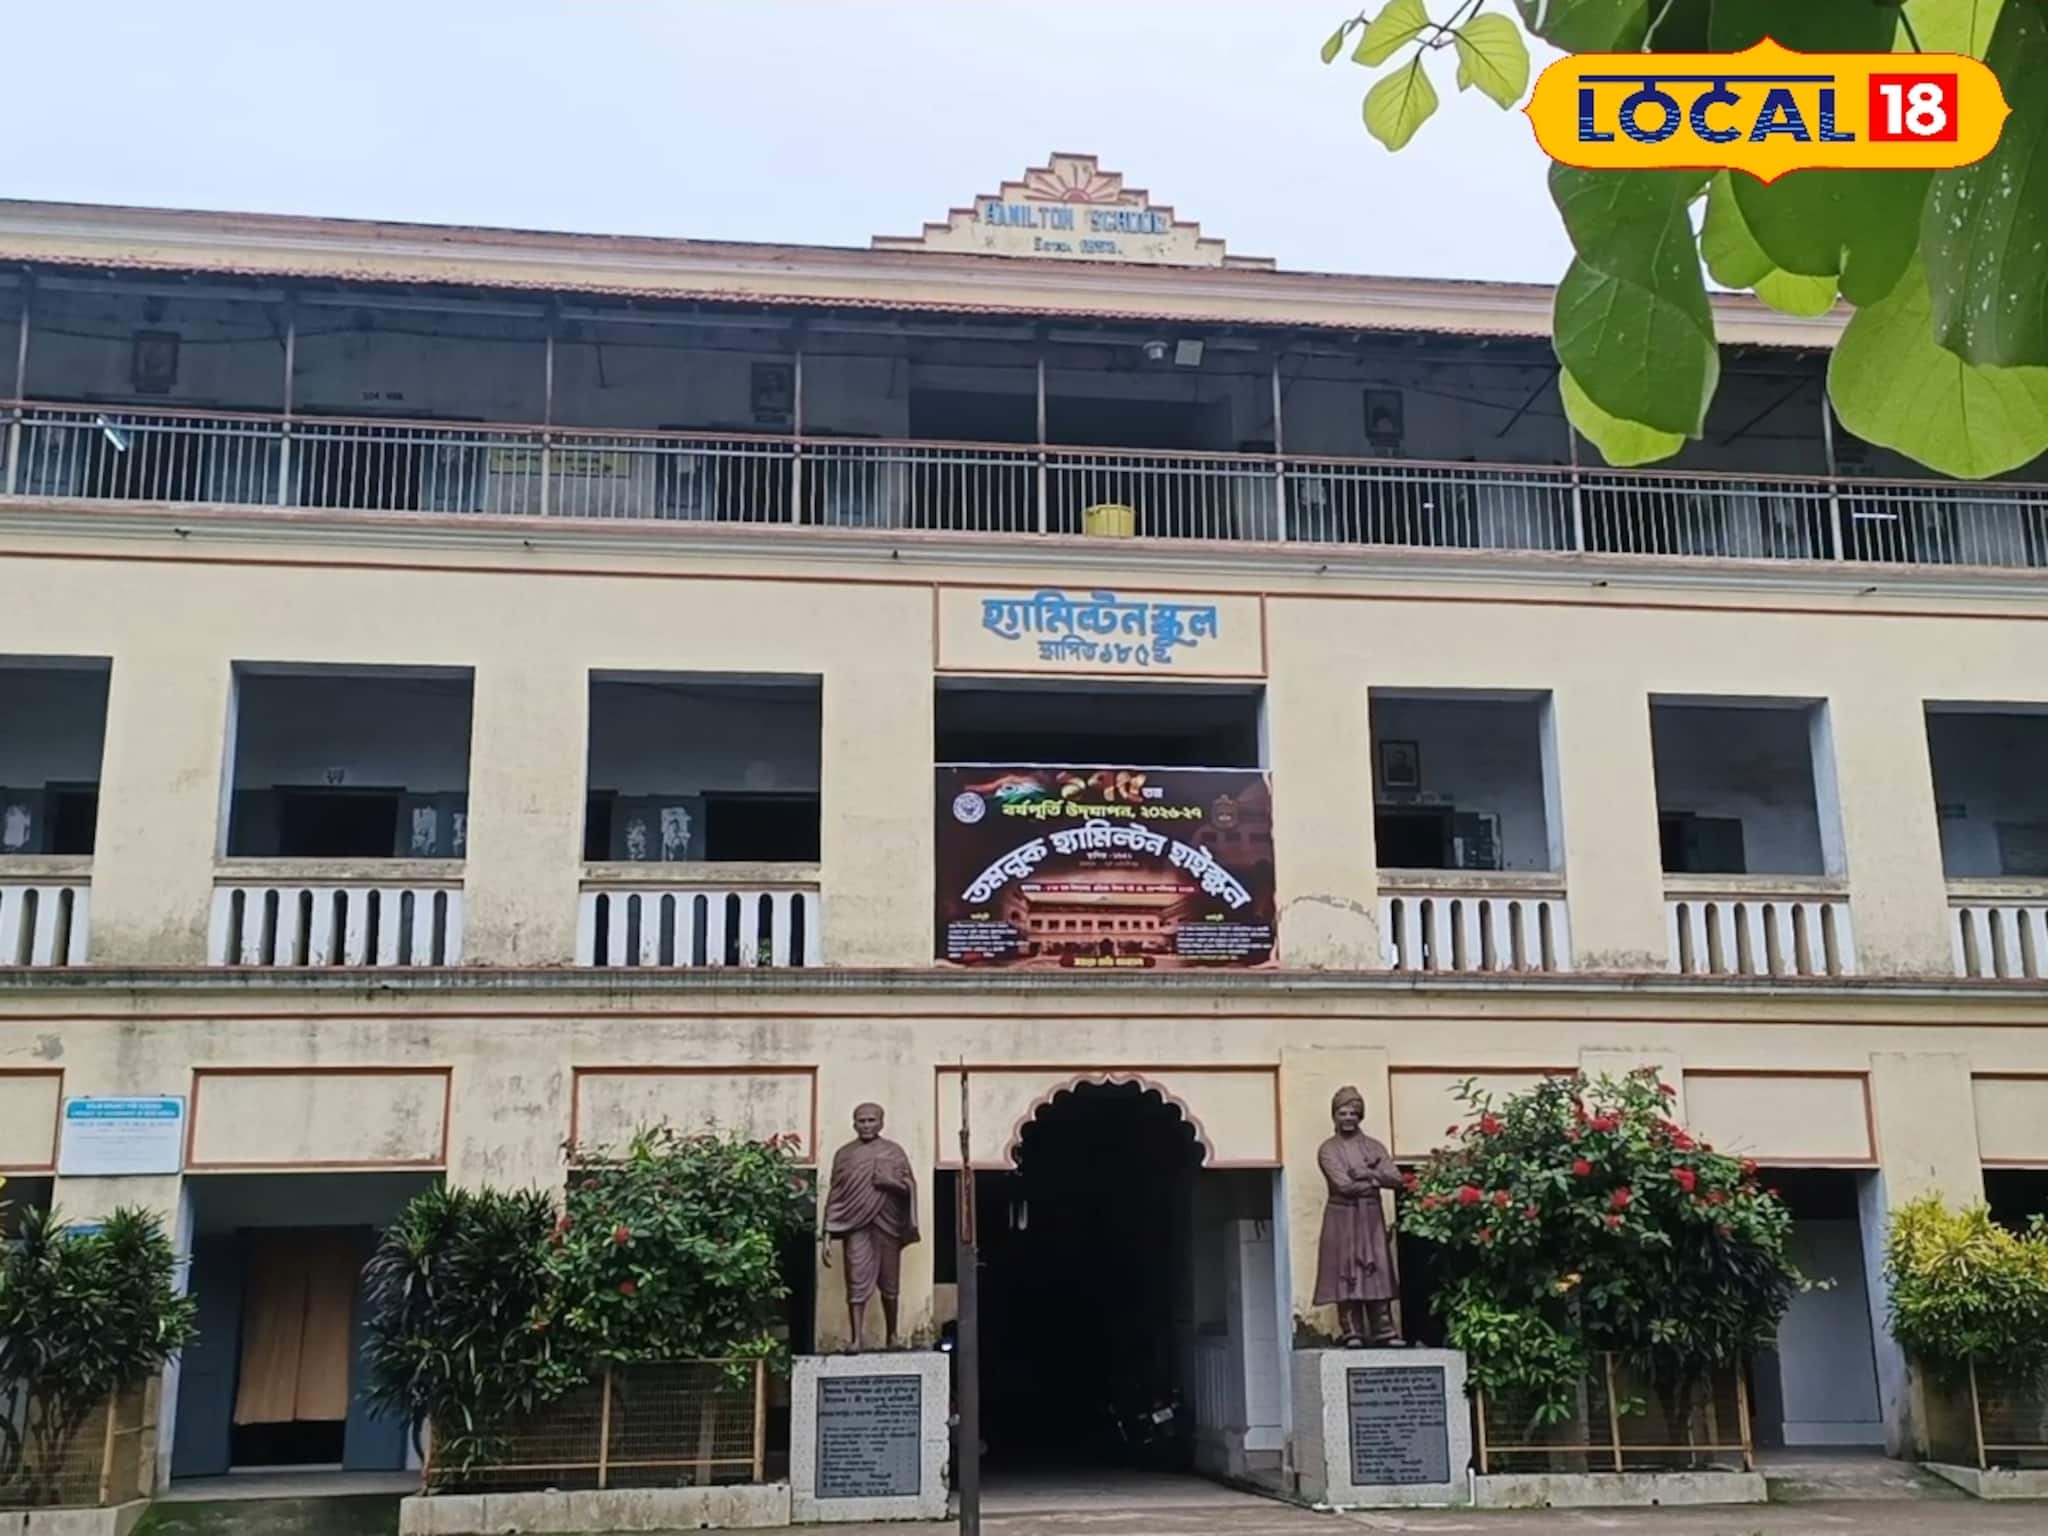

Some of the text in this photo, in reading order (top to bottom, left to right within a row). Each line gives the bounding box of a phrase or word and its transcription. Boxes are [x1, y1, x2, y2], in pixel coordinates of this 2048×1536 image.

[985, 201, 1074, 232] HAMILTON
[961, 818, 1252, 910] তমলুক হ্যামিল্টন হাইস্কুল
